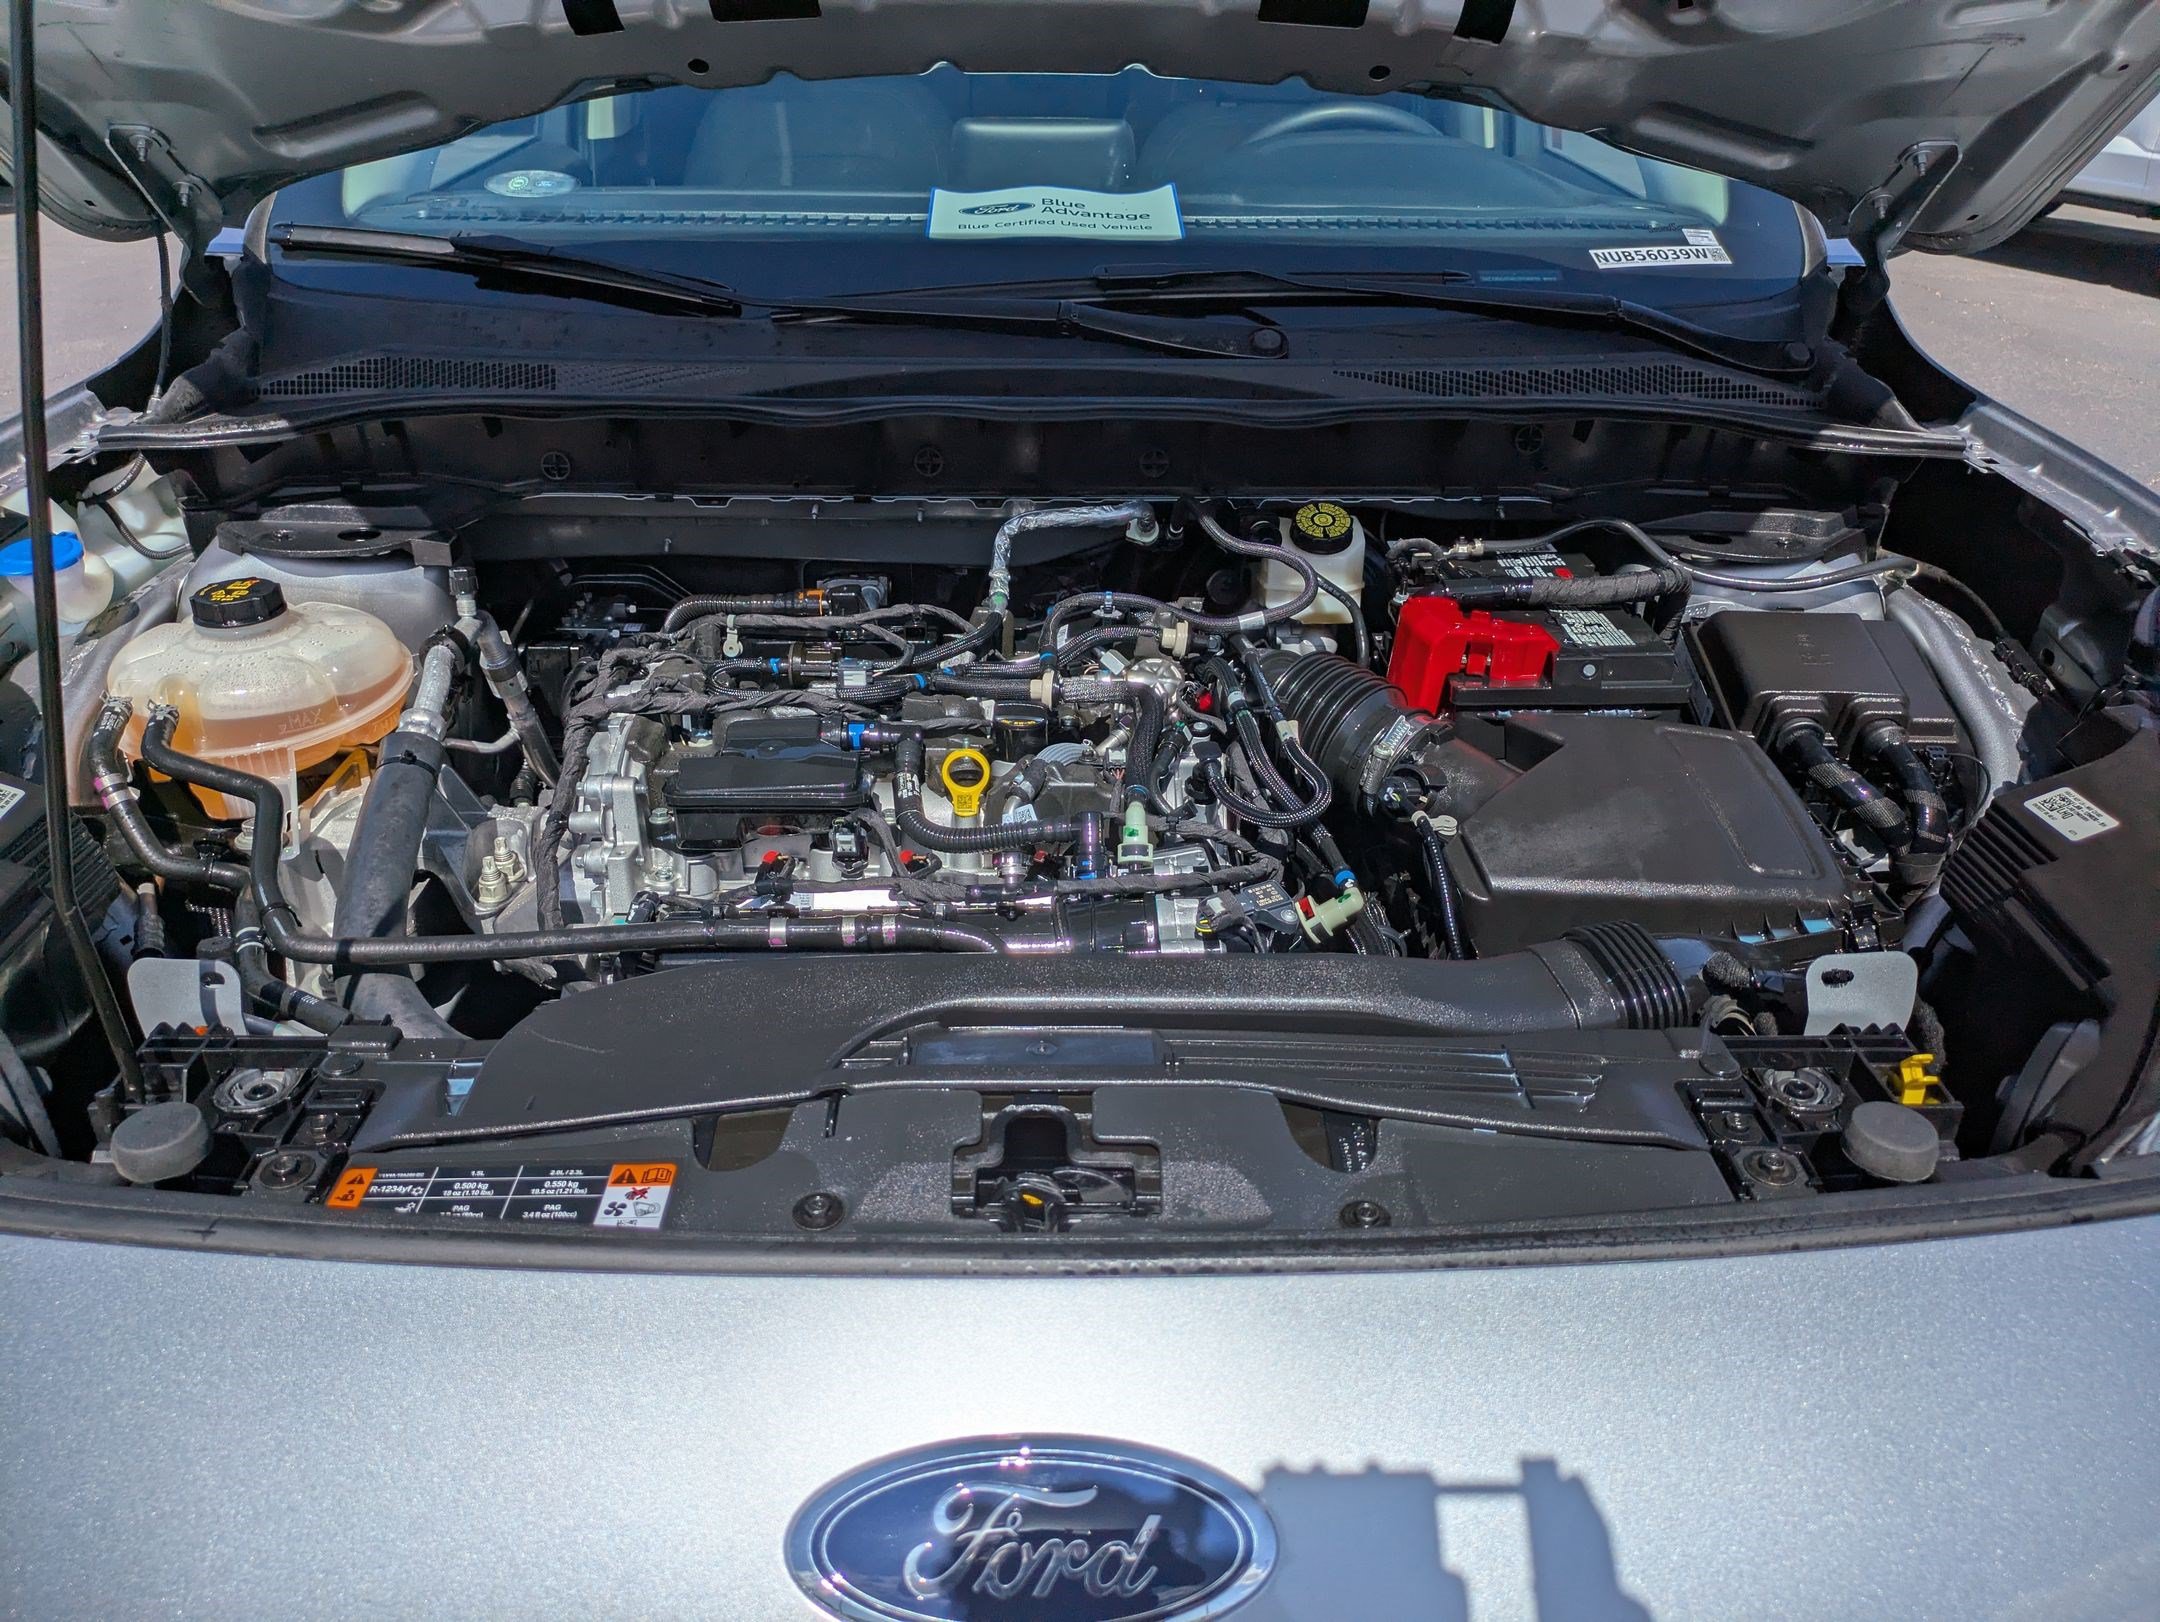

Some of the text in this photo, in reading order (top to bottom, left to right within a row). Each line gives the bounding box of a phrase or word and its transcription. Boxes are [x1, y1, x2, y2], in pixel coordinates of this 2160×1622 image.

[1041, 198, 1086, 209] Blue
[1041, 206, 1151, 221] Advantage
[994, 219, 1055, 229] Certified
[1061, 220, 1096, 229] Used
[1101, 223, 1153, 231] Vehicle
[1593, 248, 1708, 263] NUB56039W
[369, 1184, 413, 1194] R-1234yf
[454, 1182, 489, 1191] 0.500 kg
[567, 1180, 579, 1189] kg
[551, 1211, 577, 1219] (100cc)
[903, 1482, 1160, 1600] Ford
